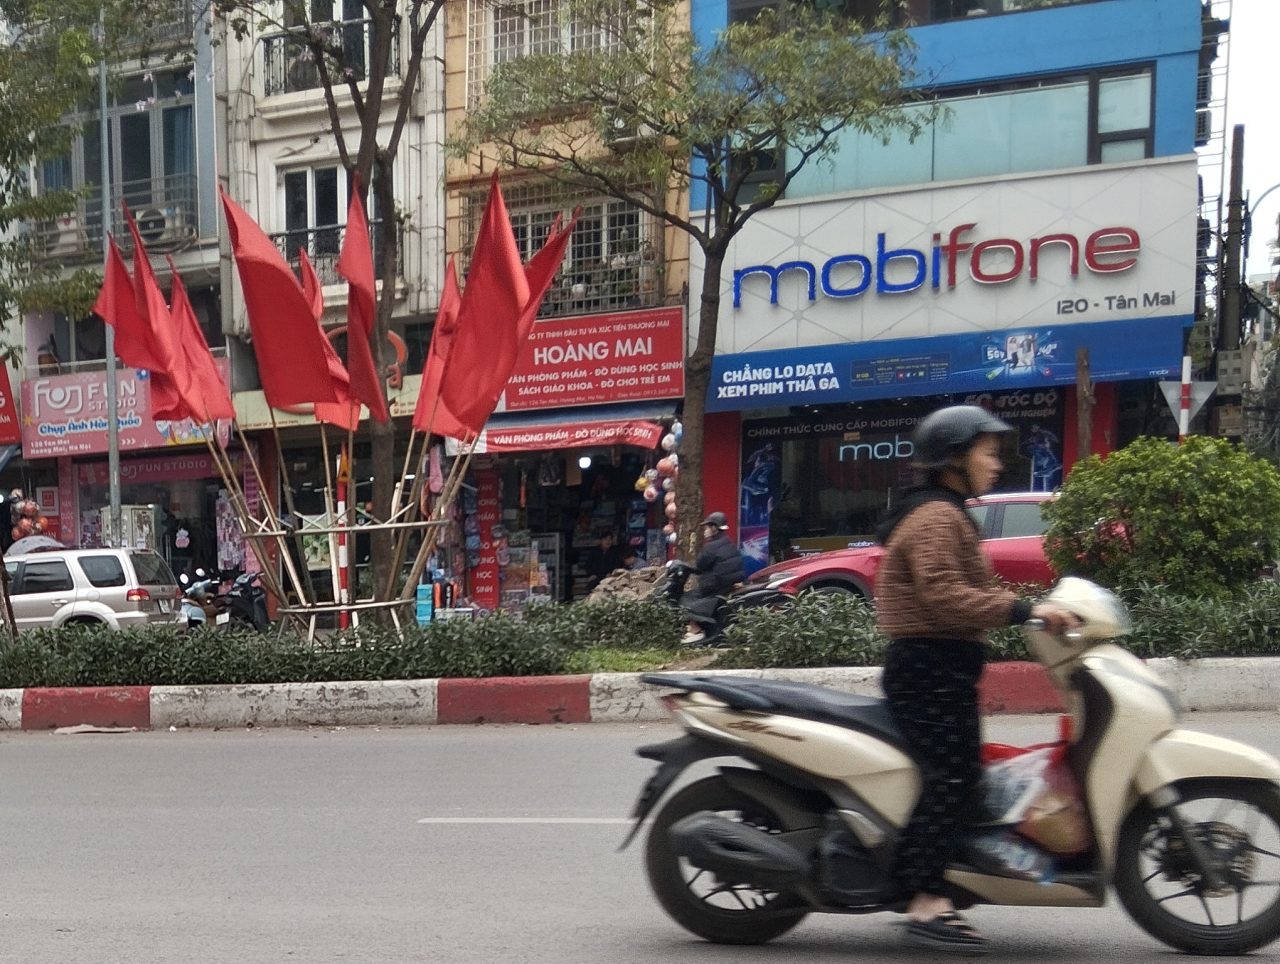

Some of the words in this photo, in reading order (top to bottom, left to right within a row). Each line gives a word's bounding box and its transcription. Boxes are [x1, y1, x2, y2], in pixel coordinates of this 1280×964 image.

[733, 222, 1141, 308] mobifone
[1056, 299, 1088, 314] 120
[1105, 294, 1137, 311] Tân
[1143, 291, 1176, 307] Mai
[534, 340, 609, 366] HOÀNG
[614, 336, 653, 358] MAI
[527, 370, 559, 383] PHÒNG
[661, 361, 682, 371] SINH
[723, 362, 772, 383] CHẲNG
[774, 366, 794, 379] LO
[796, 361, 834, 377] DATA
[567, 381, 593, 392] KHOA
[657, 375, 670, 384] EM
[717, 386, 748, 399] XEM
[749, 381, 784, 395] PHIM
[786, 376, 816, 393] THẢ
[818, 377, 840, 390] GA
[39, 422, 66, 436] Chụp
[783, 421, 812, 435] THỨC
[814, 422, 844, 433] CUNG
[846, 417, 868, 431] CẤP
[513, 432, 544, 444] PHÒNG
[138, 461, 161, 473] FUN
[163, 459, 207, 472] STUDIO
